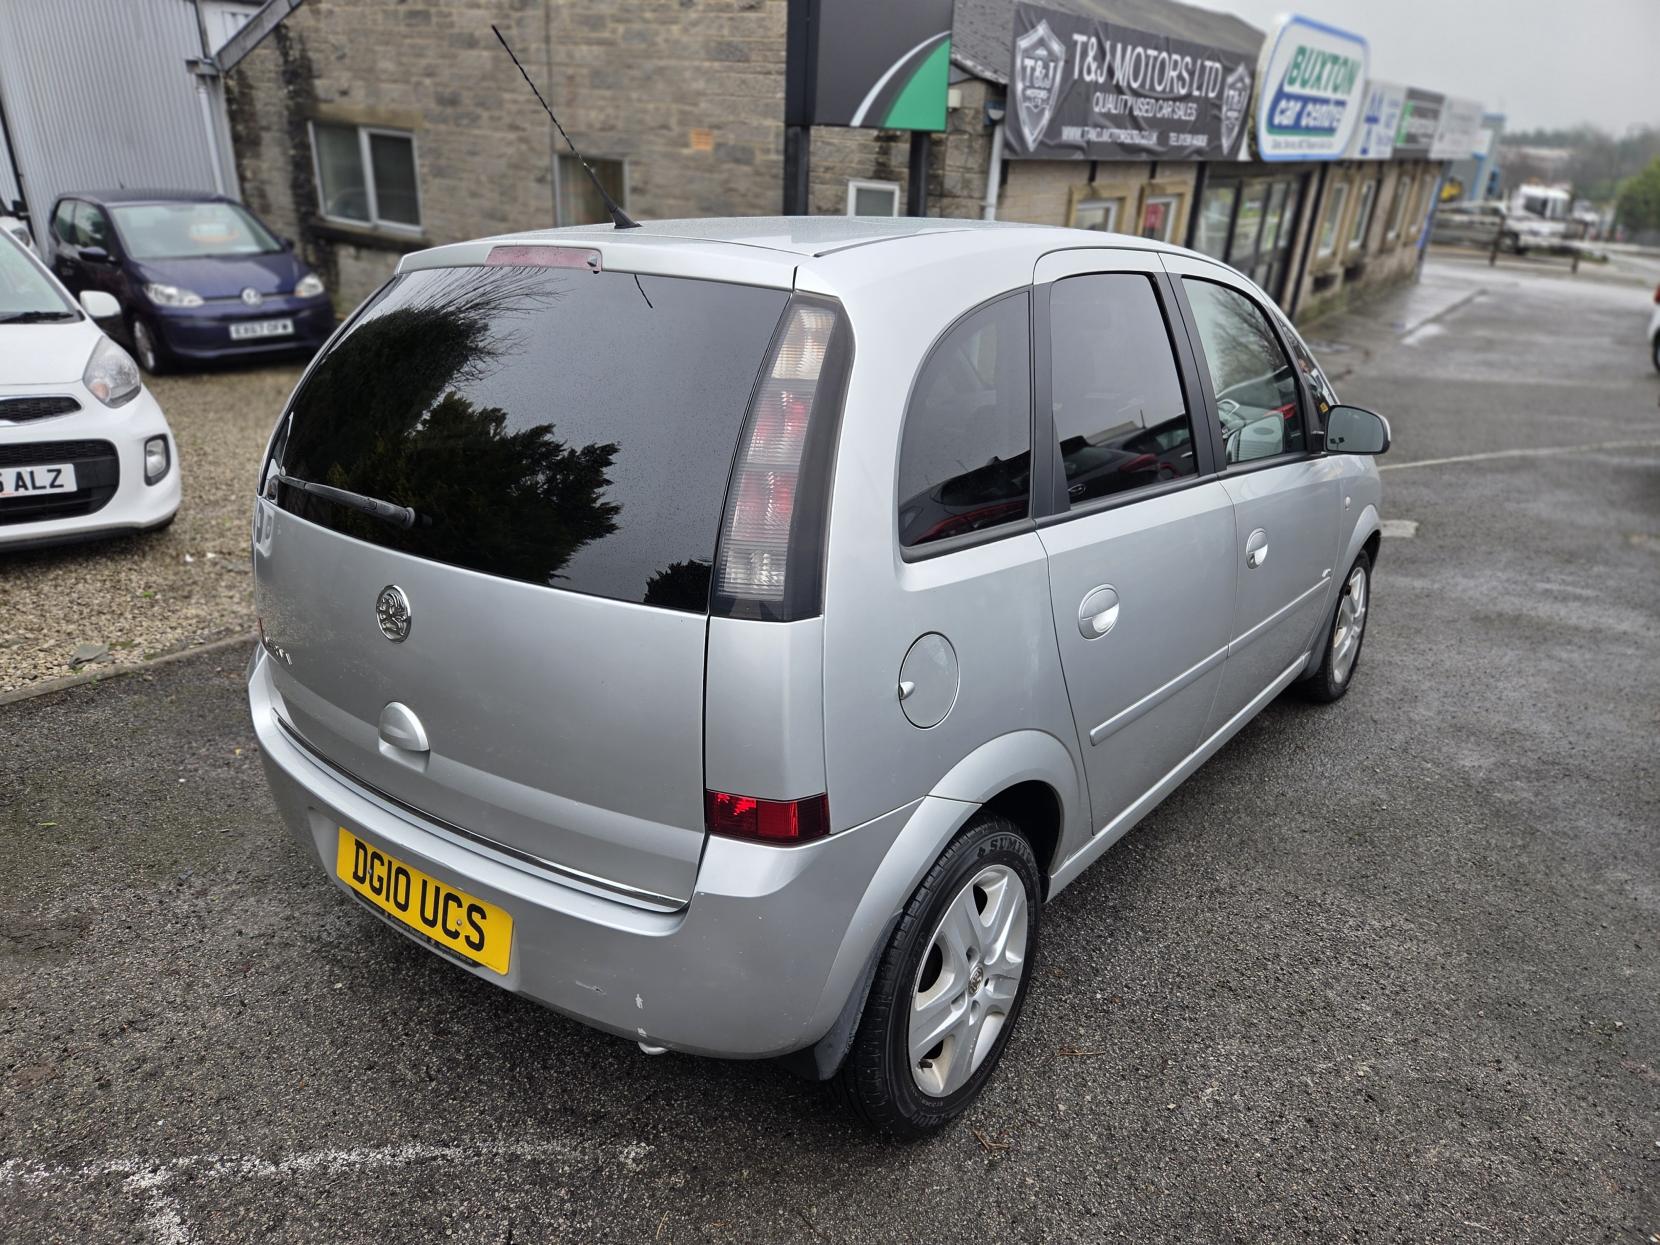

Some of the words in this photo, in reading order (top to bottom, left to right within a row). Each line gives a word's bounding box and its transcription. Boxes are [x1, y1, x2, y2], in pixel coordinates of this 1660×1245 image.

[1023, 58, 1055, 89] T&J
[1072, 33, 1110, 83] T&J
[1112, 43, 1192, 95] MOTORS
[1192, 59, 1222, 97] LTD
[1287, 45, 1361, 97] BUXTON
[1093, 91, 1132, 114] QUALITY
[1132, 97, 1156, 116] USED
[1156, 99, 1173, 118] CAR
[1173, 101, 1197, 120] SALES
[1274, 98, 1303, 126] car
[14, 468, 64, 492] ALZ
[352, 838, 411, 913] DG10
[419, 879, 488, 952] UCS
